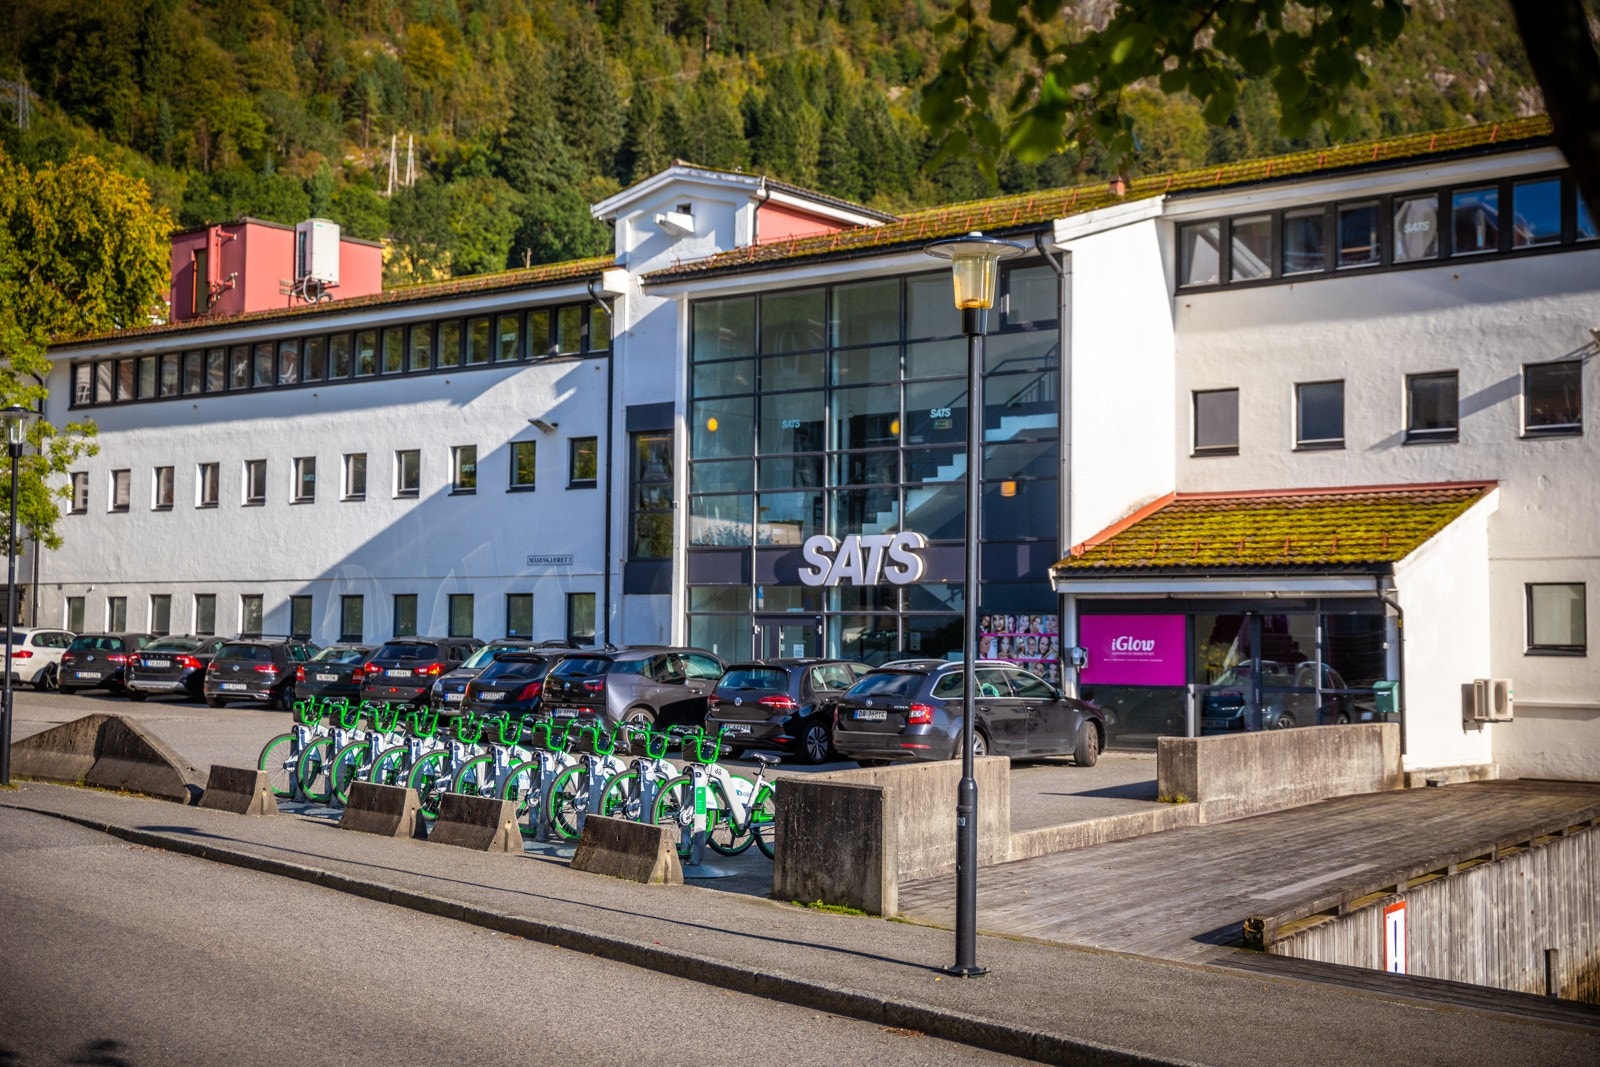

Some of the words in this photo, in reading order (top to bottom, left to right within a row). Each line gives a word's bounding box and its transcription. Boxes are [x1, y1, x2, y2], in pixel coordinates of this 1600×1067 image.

[1403, 221, 1430, 233] SATS
[930, 408, 951, 418] SATS
[781, 420, 801, 429] SATS
[798, 531, 927, 586] SATS
[1111, 635, 1155, 652] iGlow
